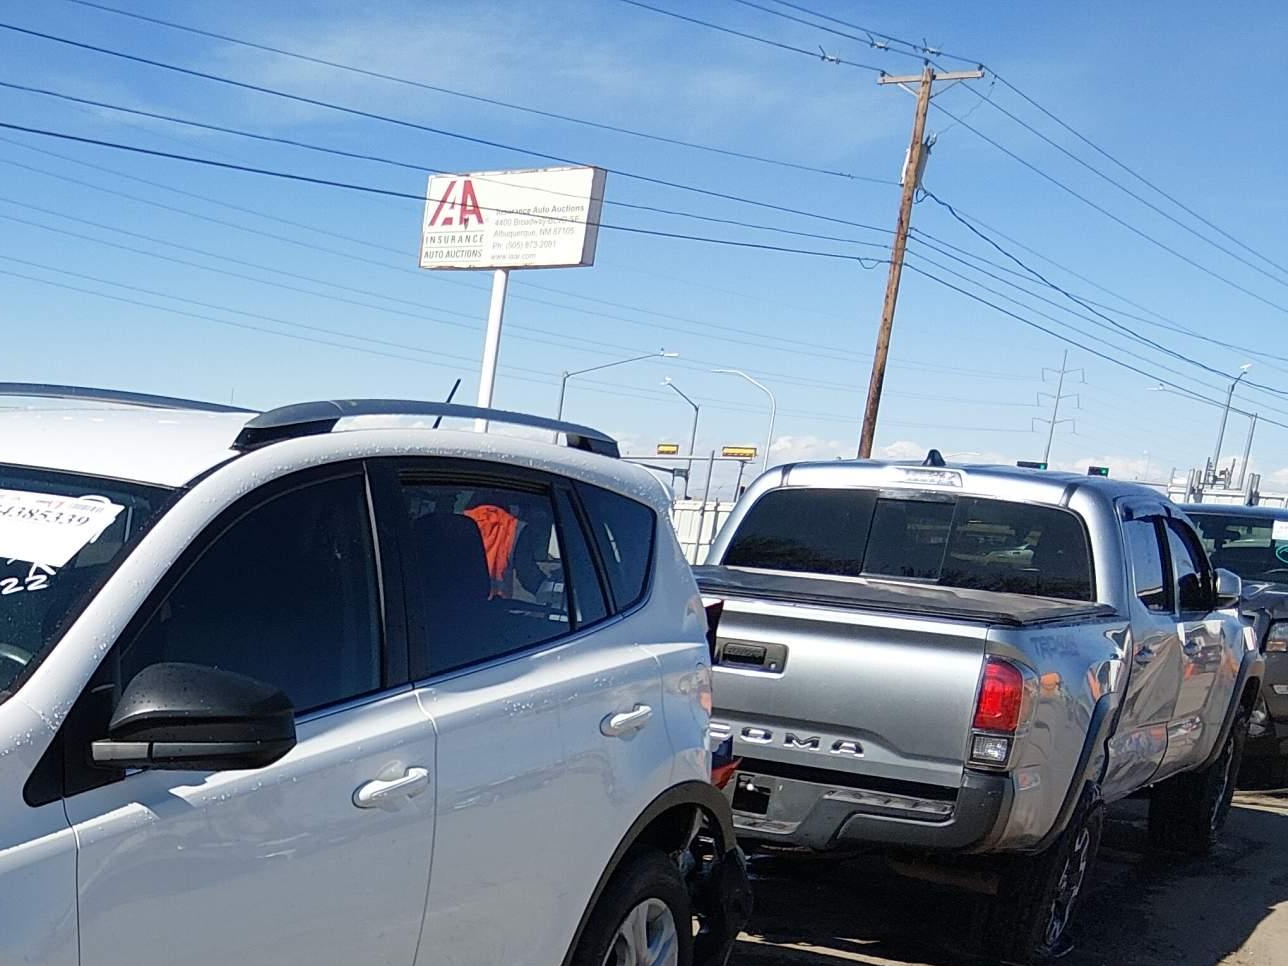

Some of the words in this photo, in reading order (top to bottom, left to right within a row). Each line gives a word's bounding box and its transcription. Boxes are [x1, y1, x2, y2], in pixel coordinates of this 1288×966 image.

[532, 205, 550, 214] Auto
[551, 204, 585, 213] Auctions
[425, 234, 485, 245] INSURANCE
[424, 250, 444, 259] AUTO
[445, 249, 482, 259] AUCTIONS
